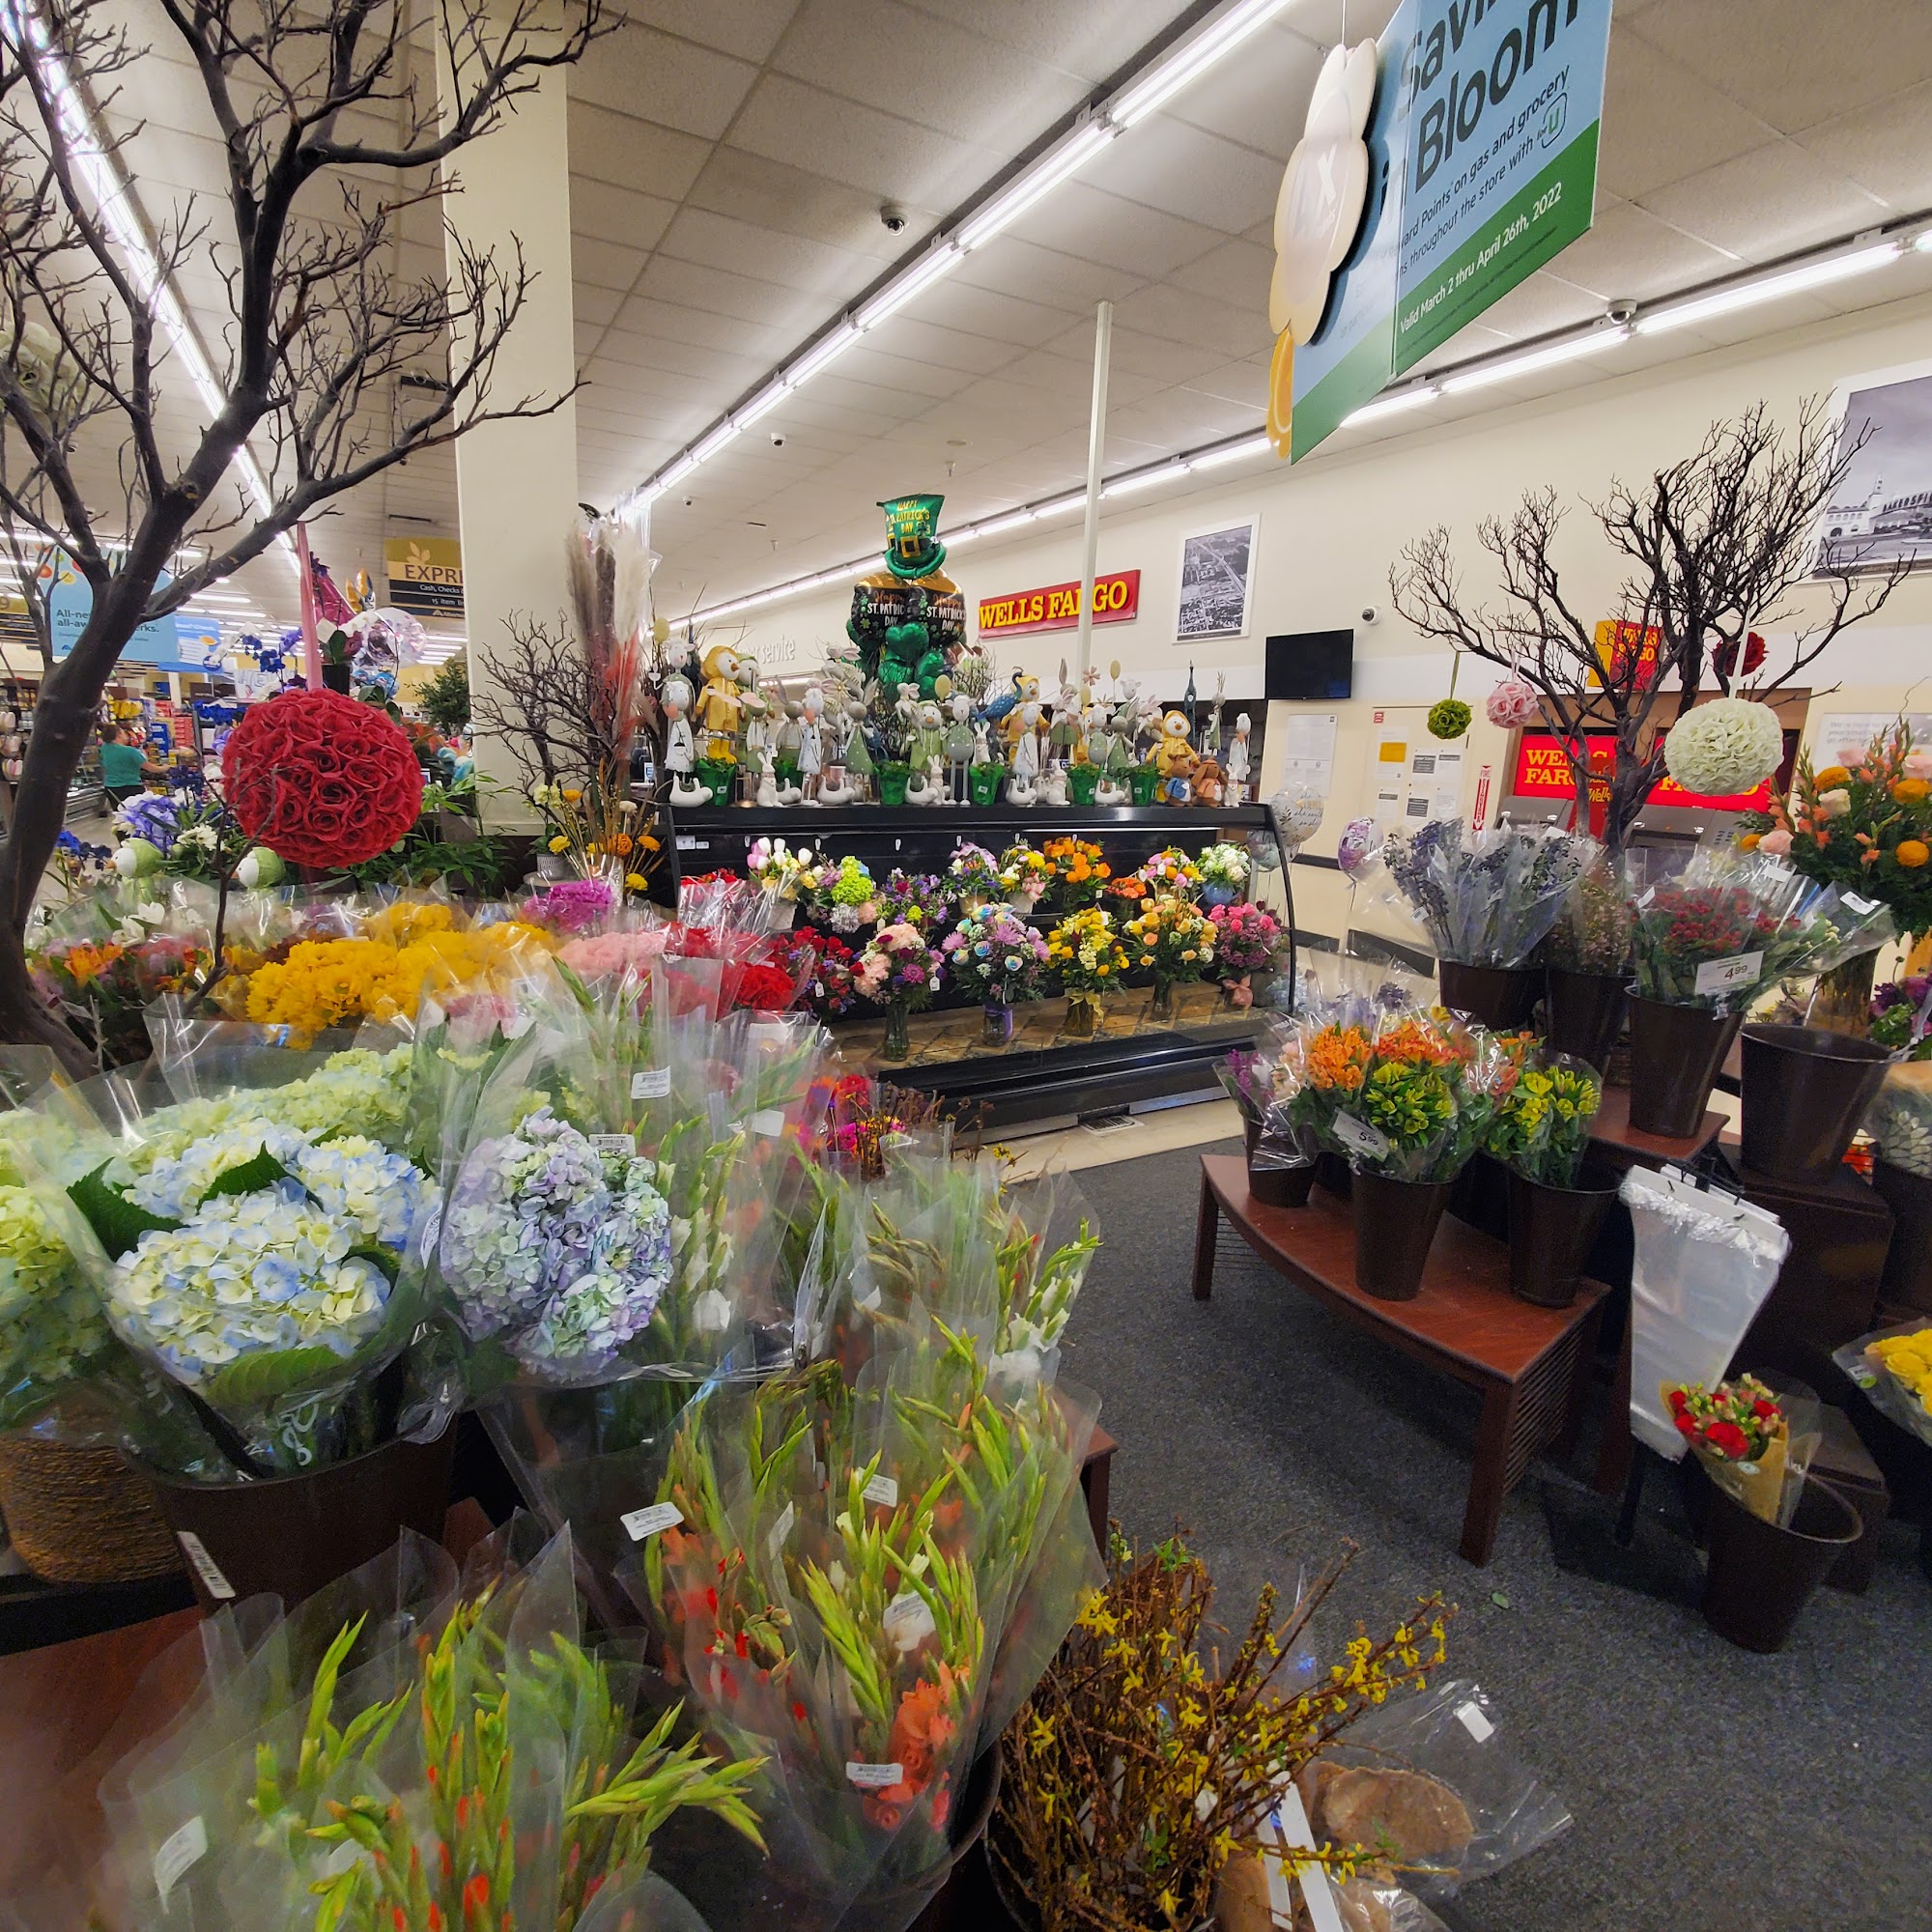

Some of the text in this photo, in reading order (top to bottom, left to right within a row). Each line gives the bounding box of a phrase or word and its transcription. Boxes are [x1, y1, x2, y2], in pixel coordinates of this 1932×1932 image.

[1421, 186, 1451, 228] Points
[1454, 170, 1467, 194] on
[1469, 149, 1490, 183] gas
[1492, 123, 1515, 156] and
[1410, 209, 1459, 268] throughout
[1461, 192, 1477, 218] the
[1479, 164, 1506, 201] store
[1509, 135, 1534, 171] with
[1400, 305, 1420, 334] Valid
[1420, 283, 1446, 318] March
[1447, 276, 1455, 296] 2
[1455, 263, 1475, 288] thru
[1476, 232, 1502, 270] April
[1531, 181, 1564, 223] 2022
[404, 563, 464, 584] EXPR
[419, 583, 438, 592] Cash,
[438, 584, 460, 594] Checks
[56, 609, 91, 619] All-ne
[880, 602, 905, 615] PATRIC
[978, 594, 1045, 630] WELLS
[884, 616, 898, 627] DAY
[941, 618, 955, 631] DAY
[761, 634, 797, 665] service
[1588, 786, 1611, 803] Wells
